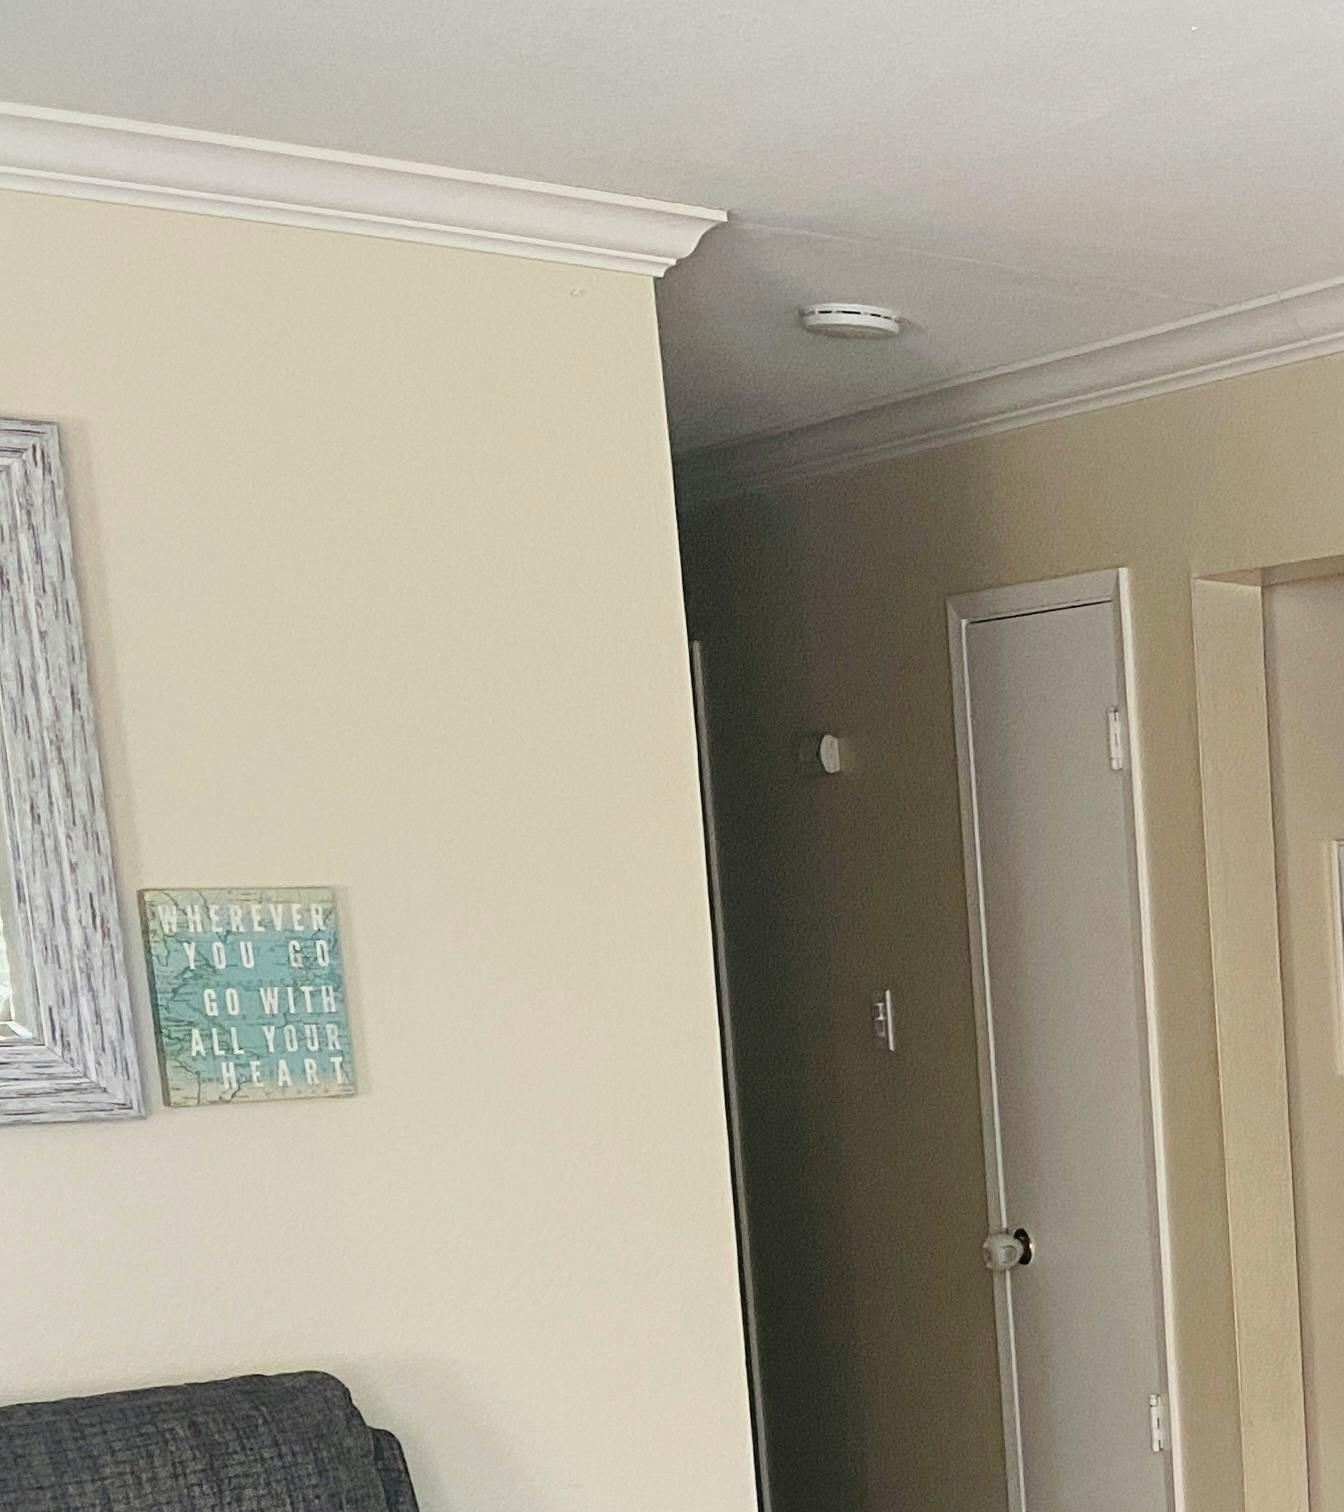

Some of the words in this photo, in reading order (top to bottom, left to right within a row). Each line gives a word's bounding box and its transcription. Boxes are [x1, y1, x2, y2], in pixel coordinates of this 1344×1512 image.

[157, 903, 325, 933] WHEREVER
[182, 941, 255, 970] YOU
[288, 939, 330, 968] GO
[203, 988, 240, 1017] GO
[260, 985, 337, 1014] WITH
[191, 1027, 245, 1056] ALL
[261, 1023, 342, 1052] YOUR
[220, 1056, 345, 1090] HEART
